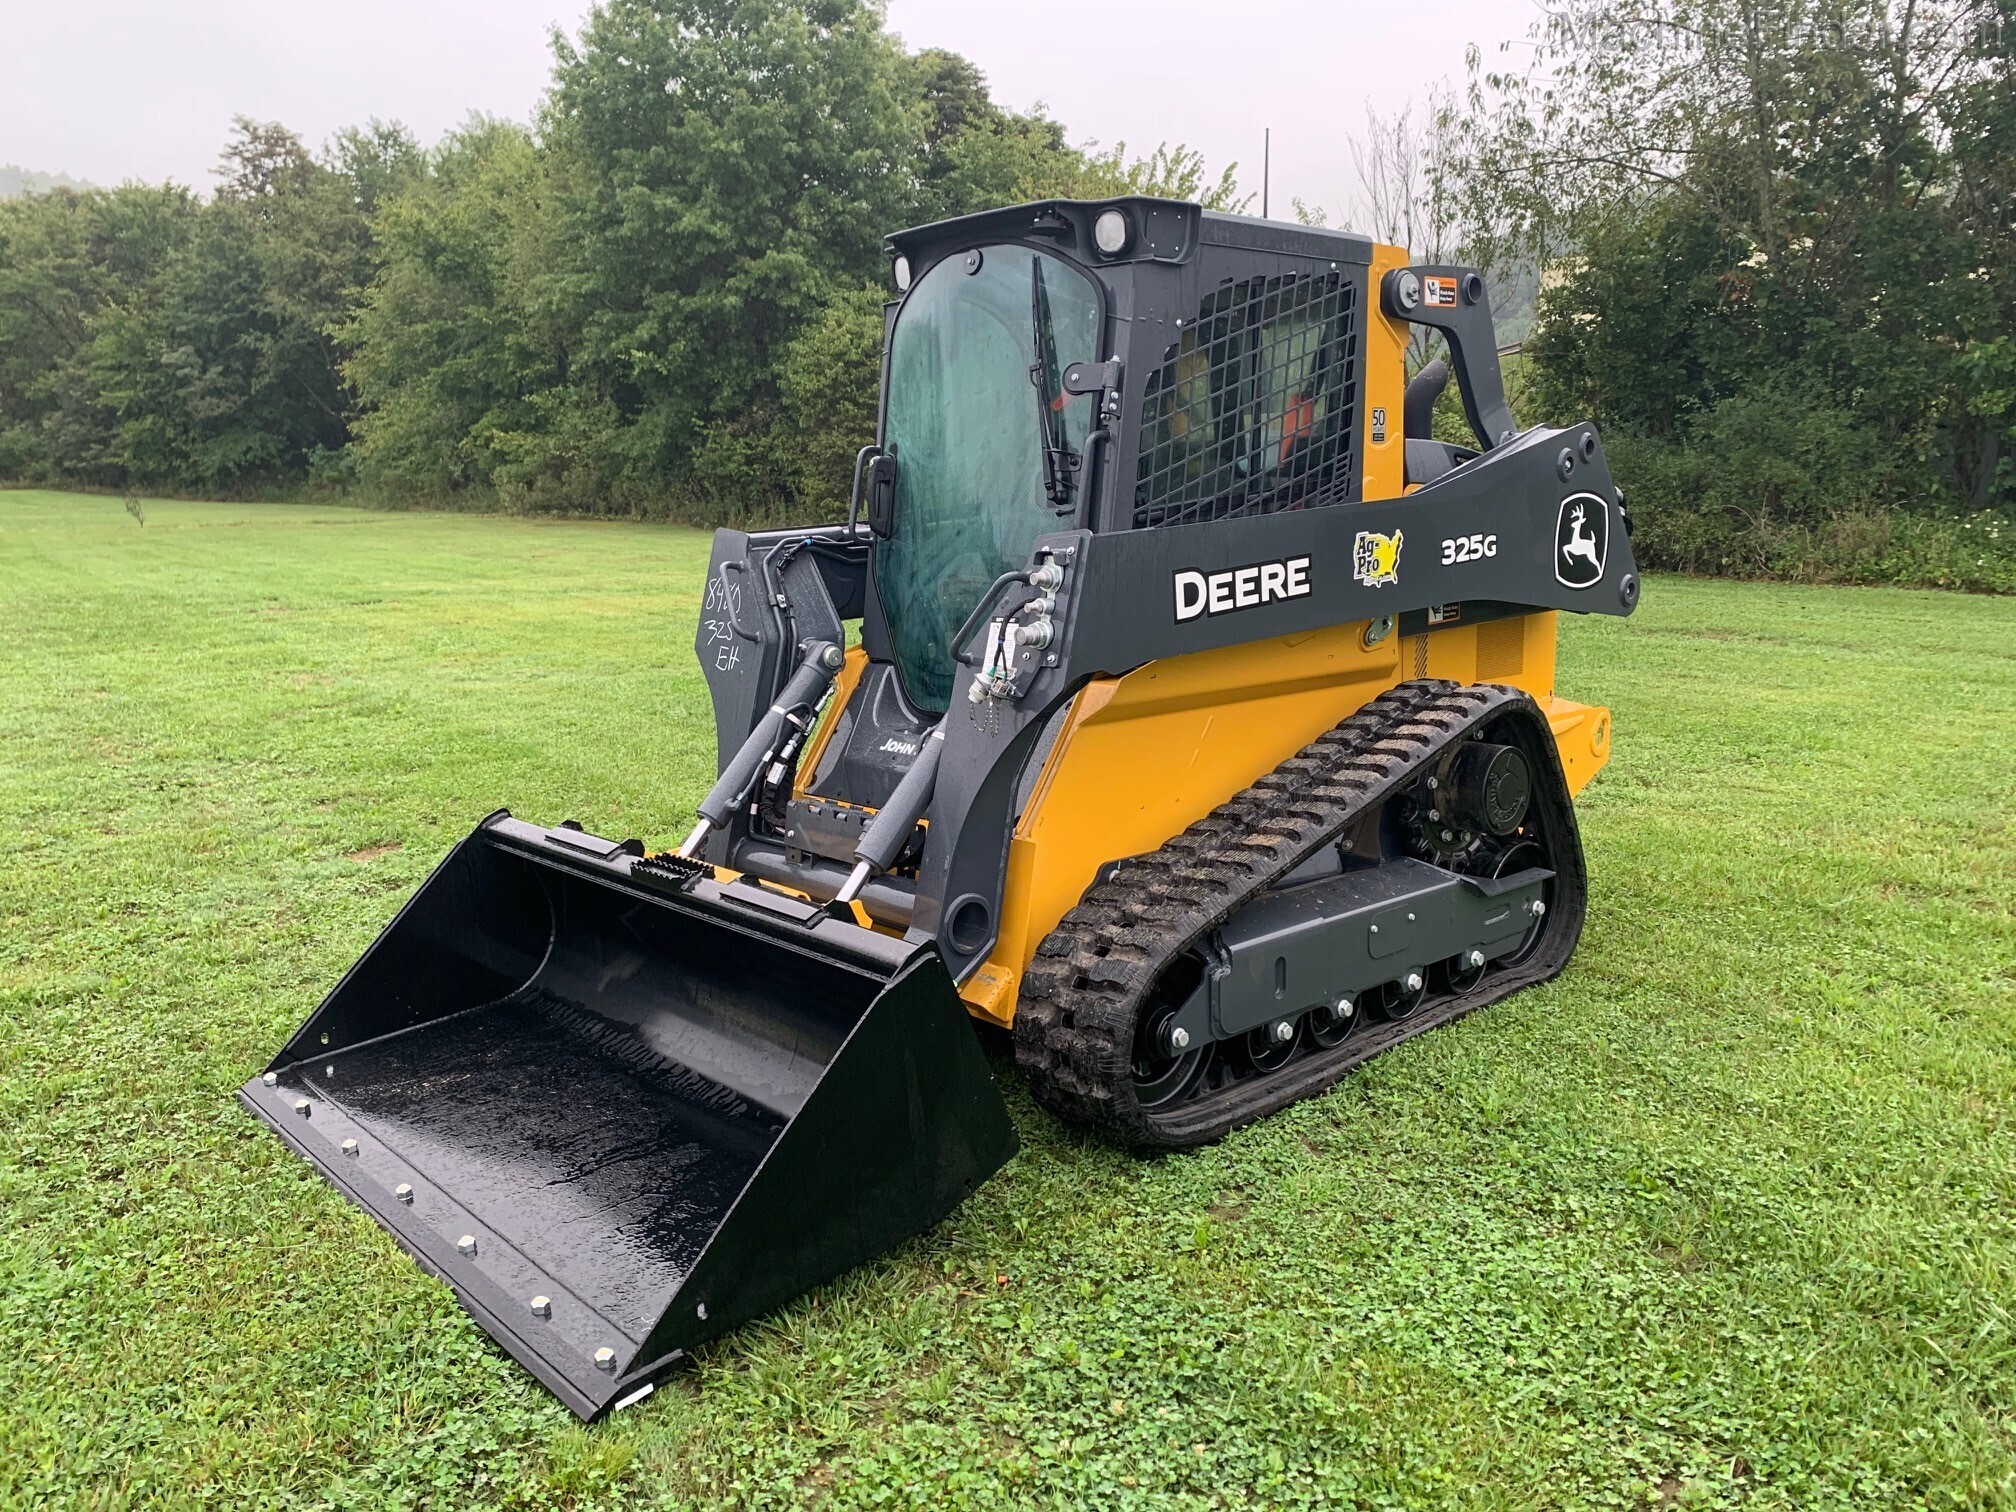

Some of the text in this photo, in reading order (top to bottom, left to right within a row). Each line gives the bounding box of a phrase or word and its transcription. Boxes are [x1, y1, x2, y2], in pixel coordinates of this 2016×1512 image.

[1373, 409, 1385, 426] 50
[1441, 533, 1497, 566] 325G
[1357, 556, 1380, 575] Pro
[1174, 557, 1311, 621] DEERE
[879, 738, 917, 755] JOHN
